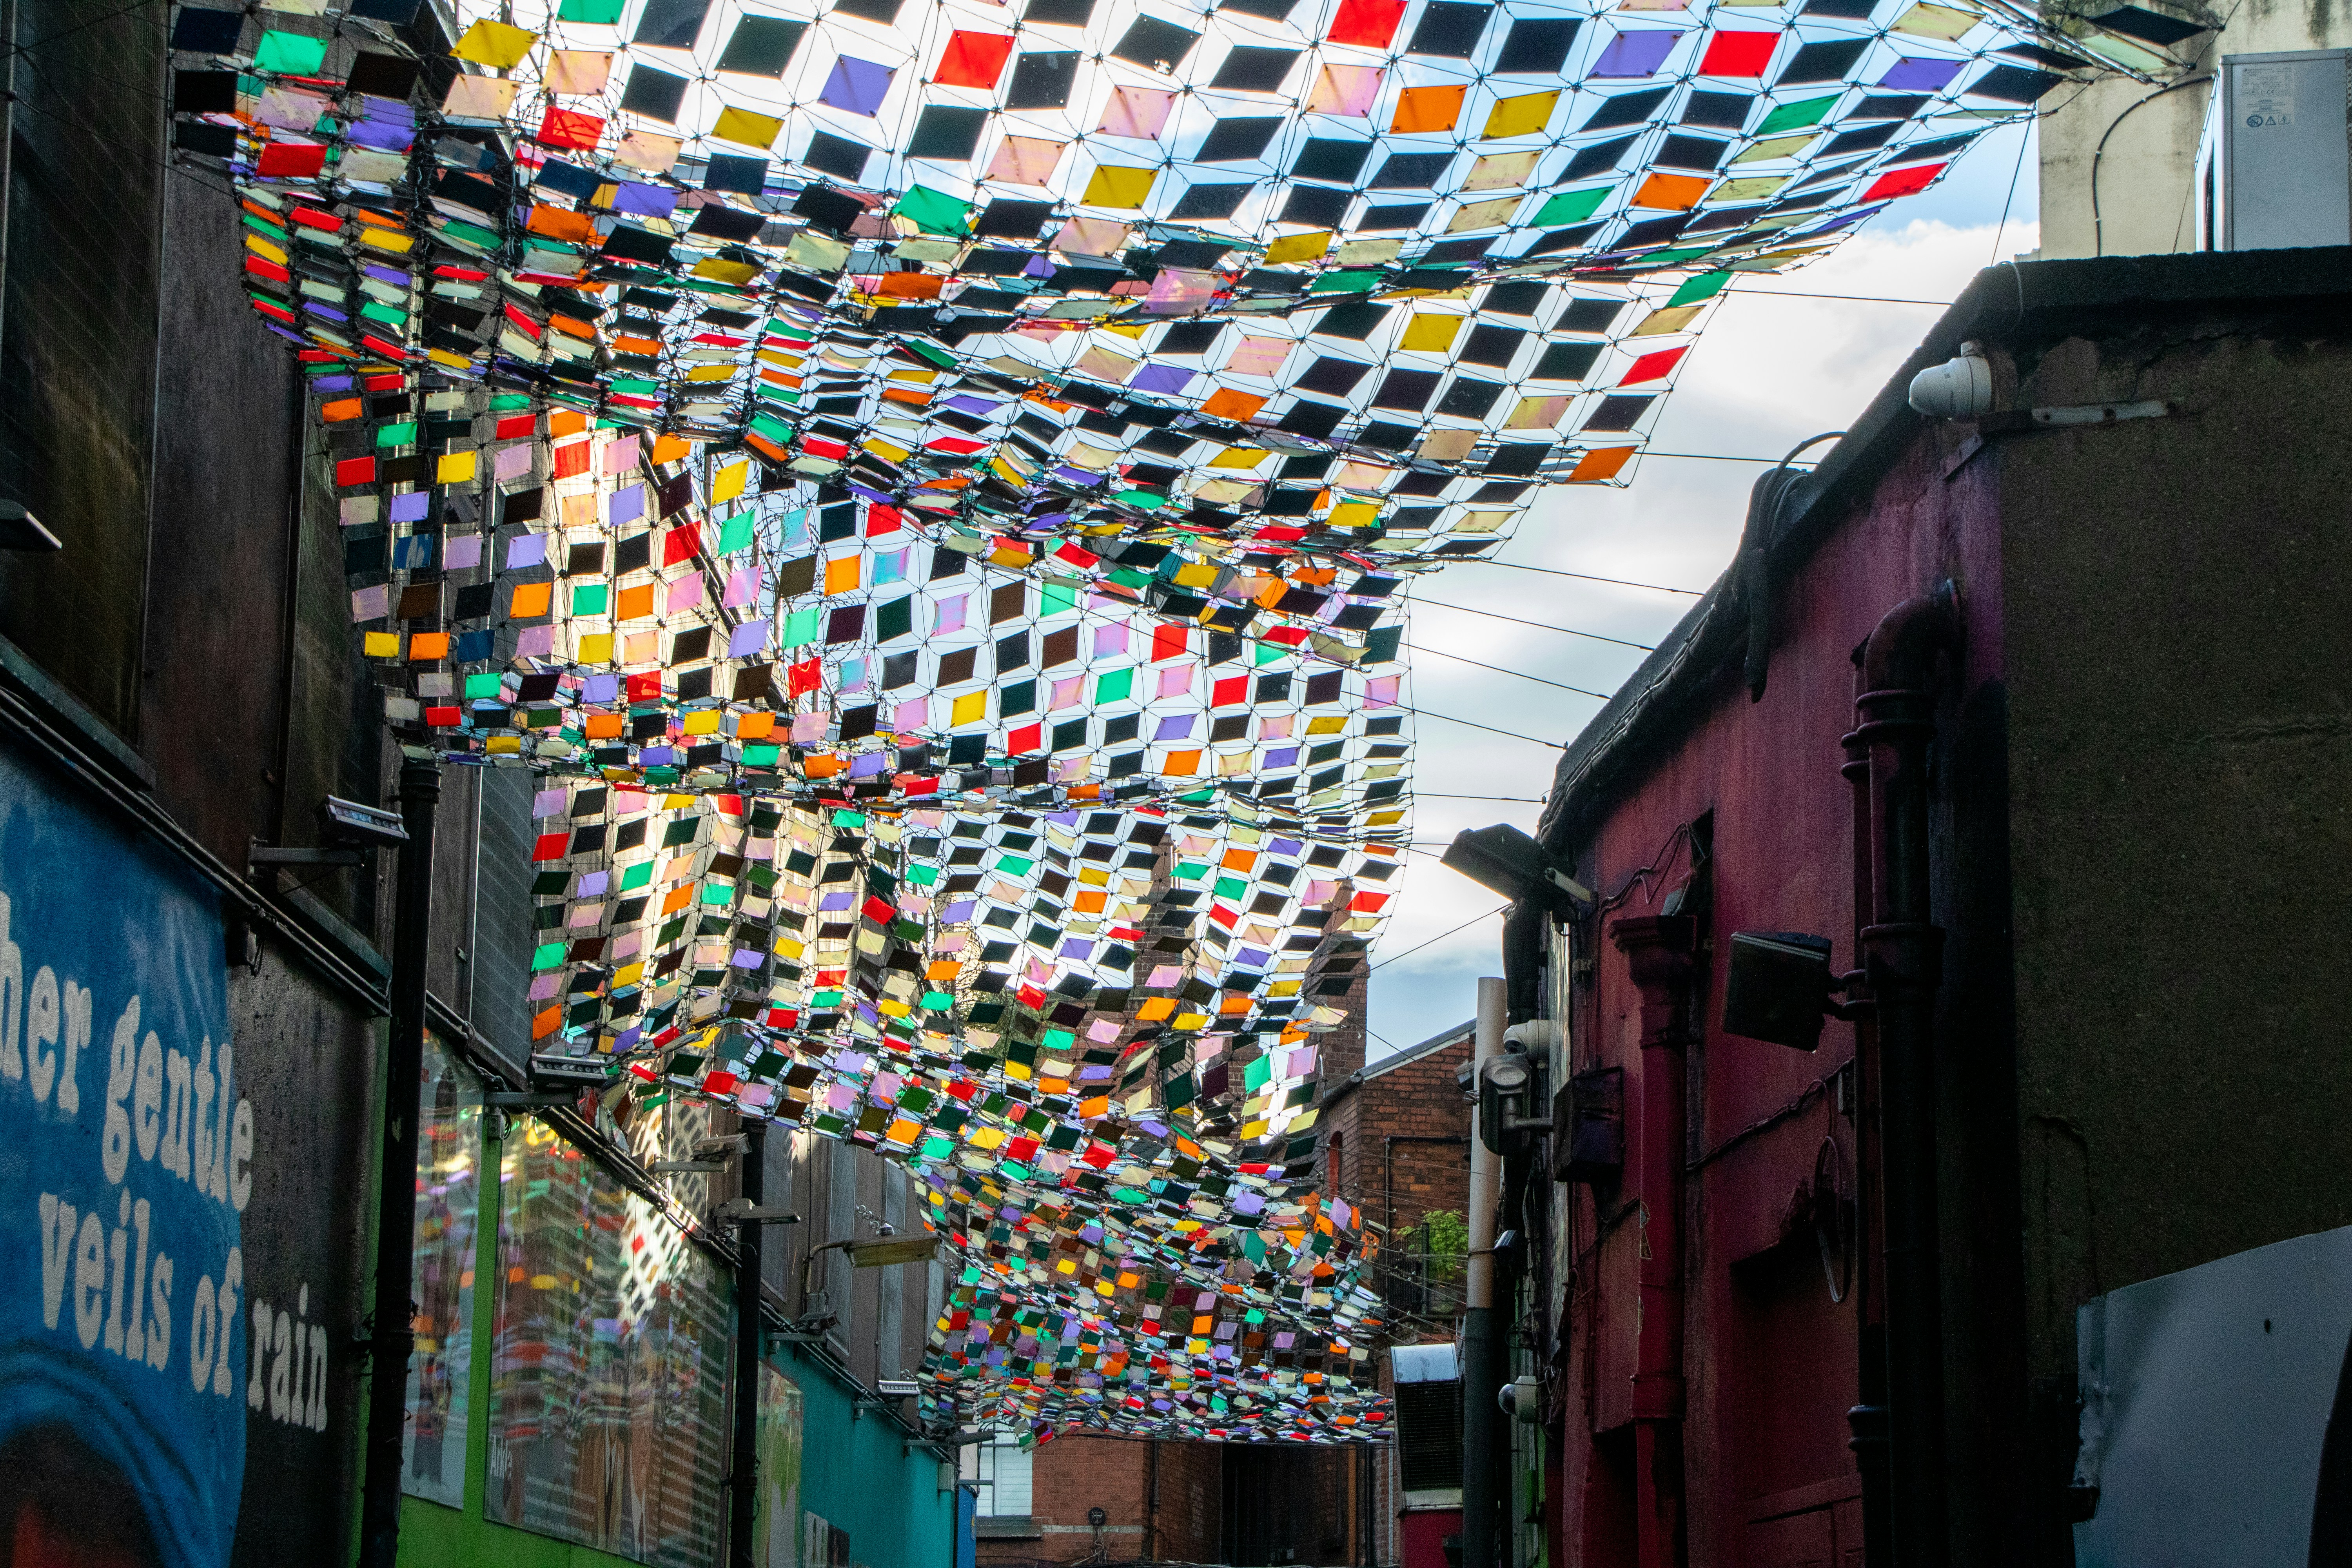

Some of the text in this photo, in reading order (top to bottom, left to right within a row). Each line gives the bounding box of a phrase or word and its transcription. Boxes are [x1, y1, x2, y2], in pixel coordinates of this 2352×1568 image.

[0, 891, 254, 1212] her gentle
[39, 1187, 328, 1433] veils of rain
